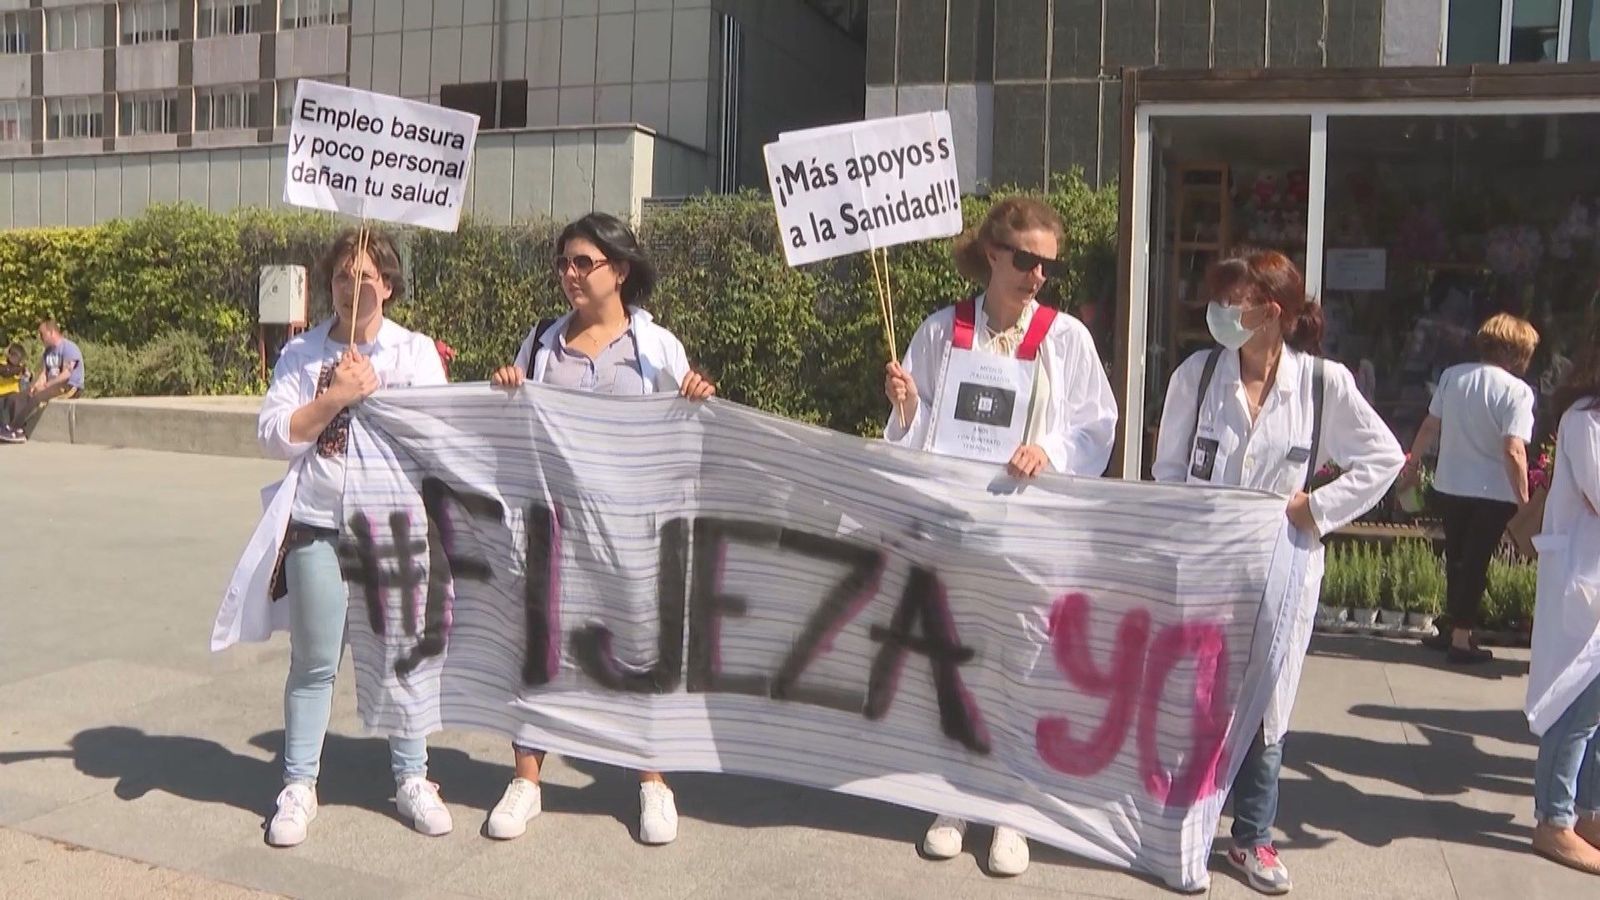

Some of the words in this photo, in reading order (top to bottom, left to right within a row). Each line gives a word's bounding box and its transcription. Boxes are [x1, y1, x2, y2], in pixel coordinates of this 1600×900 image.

[300, 98, 384, 134] Empleo
[390, 116, 465, 150] basura
[291, 133, 306, 156] y
[311, 137, 364, 163] poco
[370, 149, 465, 180] personal
[291, 162, 357, 193] dañan
[364, 176, 384, 197] tu
[390, 183, 453, 208] salud.
[775, 157, 839, 207] ¡Más
[790, 225, 807, 248] a
[809, 212, 836, 243] la
[338, 476, 990, 756] #FIJEZA
